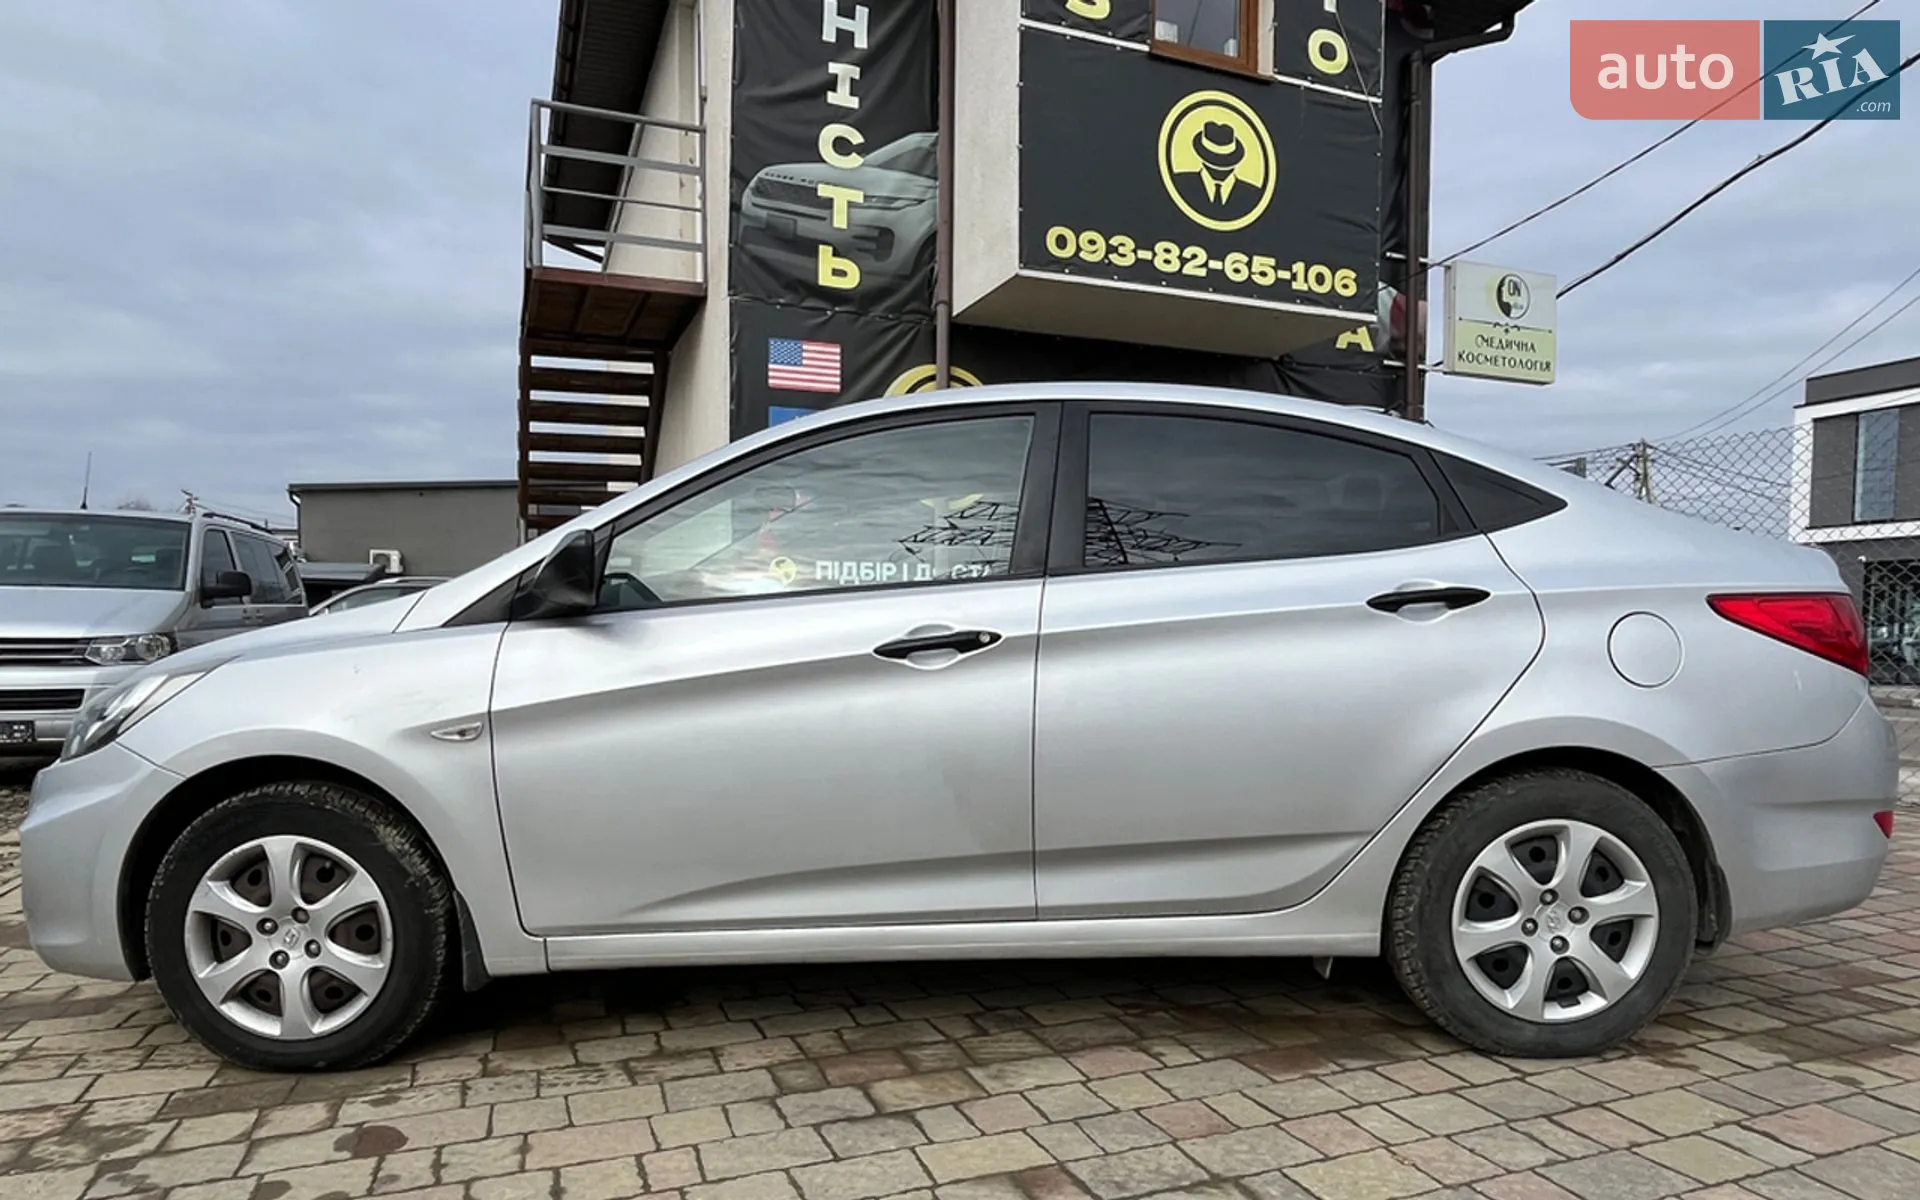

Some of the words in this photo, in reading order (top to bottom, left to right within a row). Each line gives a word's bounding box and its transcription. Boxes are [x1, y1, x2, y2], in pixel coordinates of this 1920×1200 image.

[1045, 226, 1358, 298] 093-82-65-106
[1457, 350, 1552, 373] КОСМЕТОЛОГІЯ
[815, 560, 897, 586] ПІДБІР
